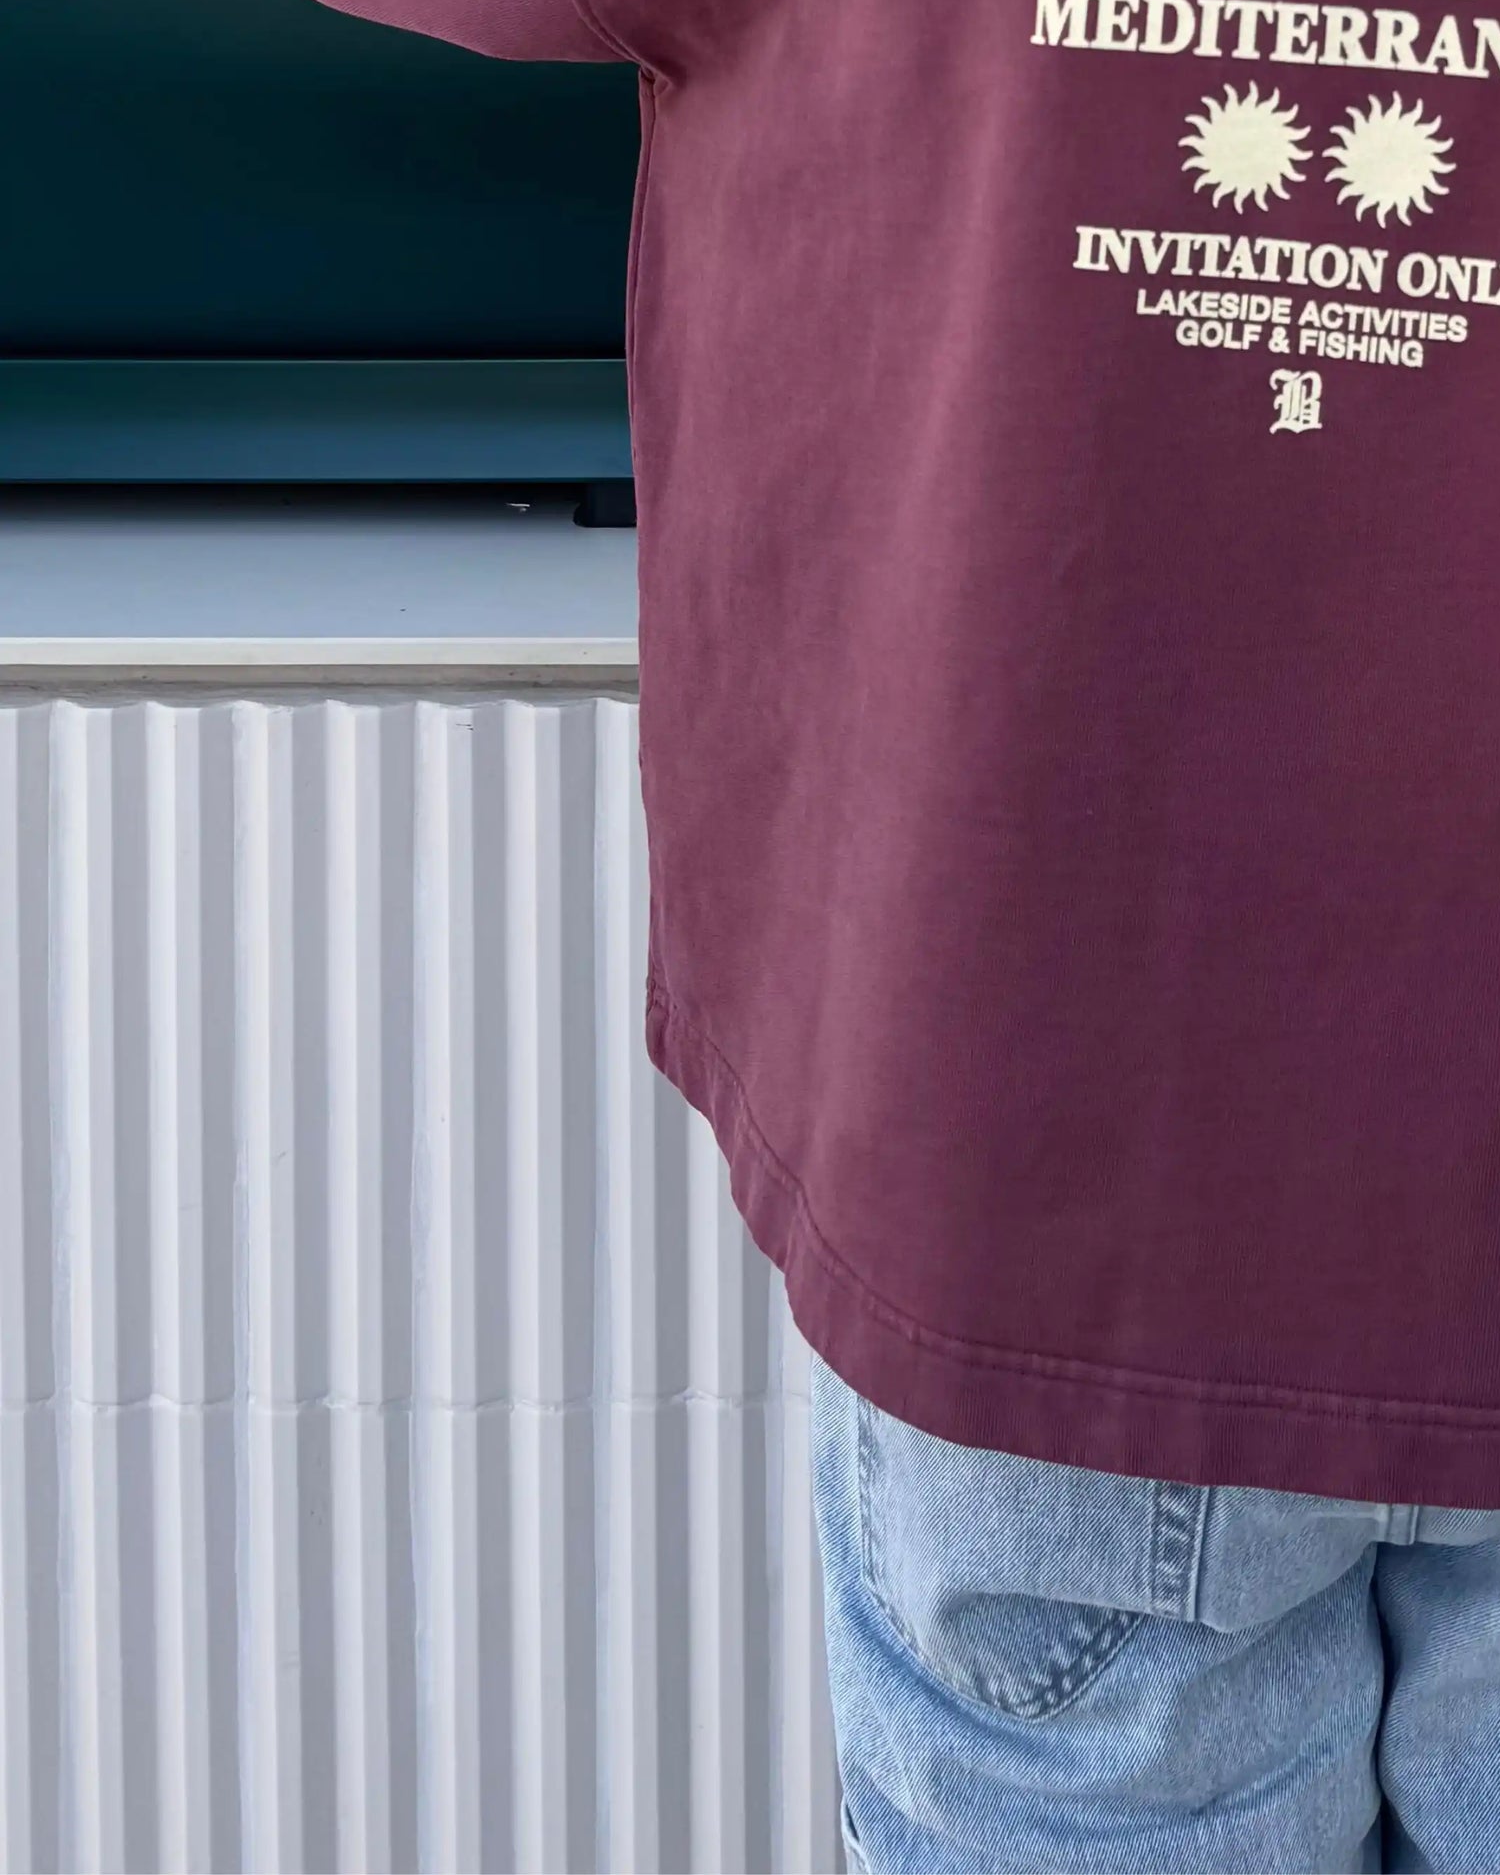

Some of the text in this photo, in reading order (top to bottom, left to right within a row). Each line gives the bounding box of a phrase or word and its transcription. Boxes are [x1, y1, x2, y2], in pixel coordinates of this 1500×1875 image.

[1072, 225, 1389, 294] INVITATION
[1136, 288, 1468, 343] LAKESIDE ACTIVITIES
[1175, 319, 1425, 368] GOLF & FISHING
[1269, 368, 1323, 434] B
